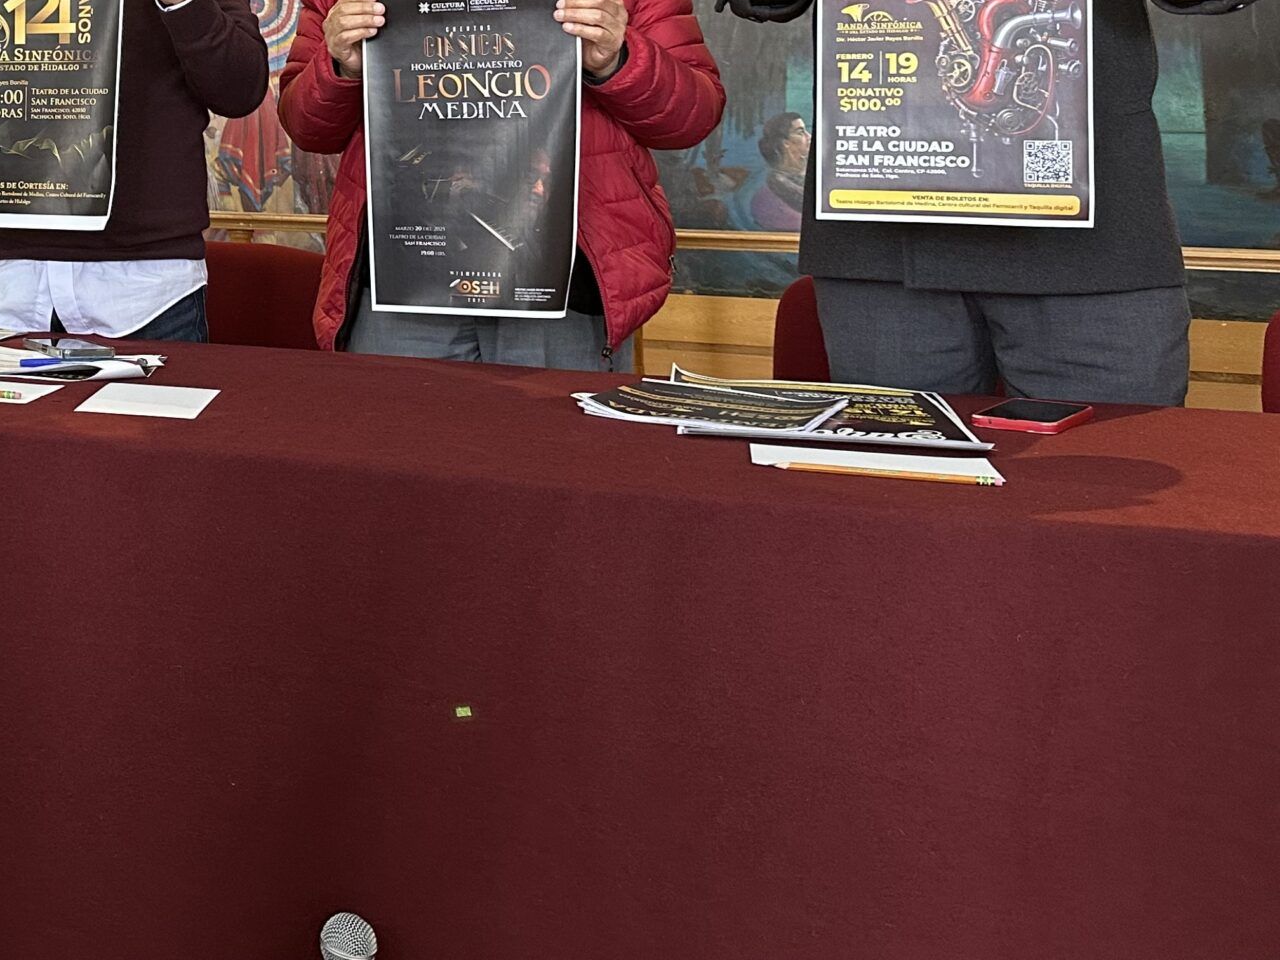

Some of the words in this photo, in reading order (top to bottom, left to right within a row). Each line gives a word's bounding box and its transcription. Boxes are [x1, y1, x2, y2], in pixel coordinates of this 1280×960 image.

[836, 22, 869, 30] BANDA
[871, 20, 923, 29] SINFÓNICA
[14, 45, 99, 61] SINFÓNICA
[41, 63, 80, 71] HIDALGO
[411, 62, 461, 71] HOMENAJE
[463, 61, 475, 69] AL
[477, 60, 523, 69] MAESTRO
[885, 52, 919, 75] 19
[837, 61, 873, 83] 14
[392, 64, 552, 103] LEONCIO
[837, 87, 904, 97] DONATIVO
[50, 97, 97, 105] FRANCISCO
[839, 97, 902, 112] $100.00
[418, 100, 528, 120] MEDINA
[835, 125, 901, 137] TEATRO
[836, 140, 859, 151] DE
[862, 140, 884, 151] LA
[887, 140, 954, 152] CIUDAD
[835, 154, 869, 166] SAN
[873, 155, 971, 168] FRANCISCO
[17, 180, 55, 190] CORTESÍA
